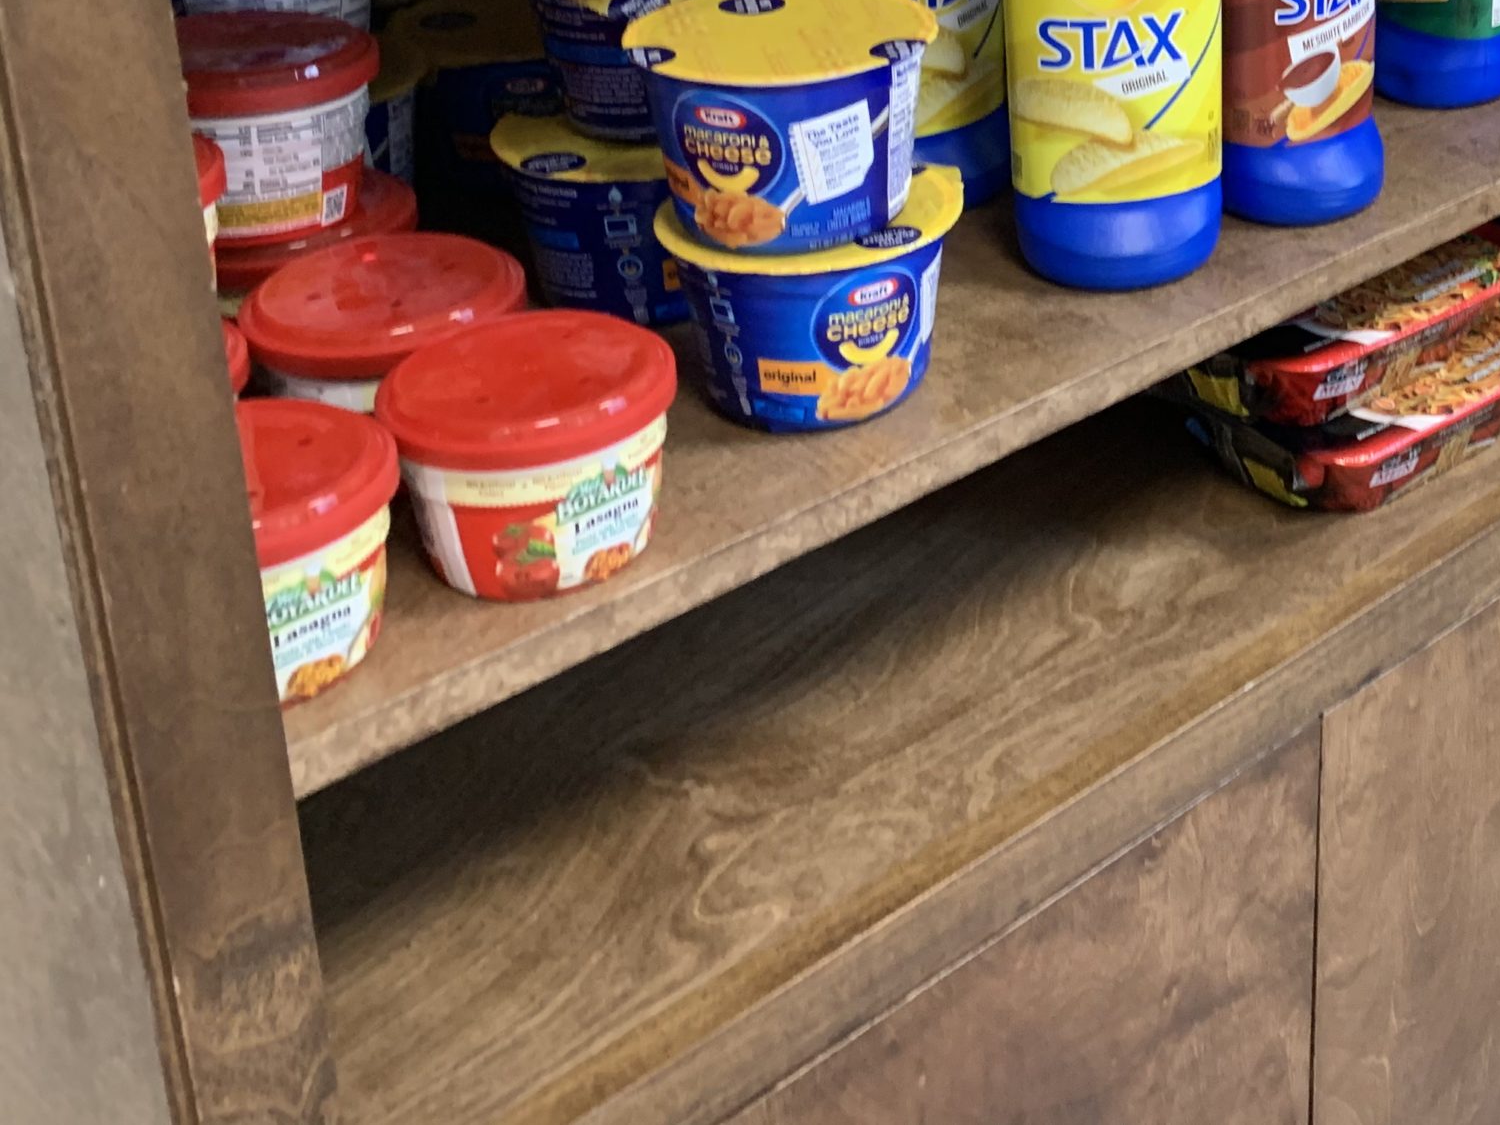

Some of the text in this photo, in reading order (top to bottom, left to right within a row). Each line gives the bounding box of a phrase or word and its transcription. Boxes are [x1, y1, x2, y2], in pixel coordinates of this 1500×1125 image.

[1037, 8, 1185, 72] STAX
[1301, 27, 1343, 52] MESQUITE
[1120, 68, 1169, 95] ORIGINAL
[702, 109, 736, 125] Kraft
[828, 114, 860, 133] Taste
[682, 124, 757, 150] macaroni
[835, 125, 860, 143] Love
[857, 284, 889, 304] Kraft
[828, 302, 902, 326] macaroni
[763, 369, 818, 388] original
[574, 496, 640, 535] Lasagna
[269, 573, 363, 627] OYARDEE
[273, 605, 352, 648] Lasagna
